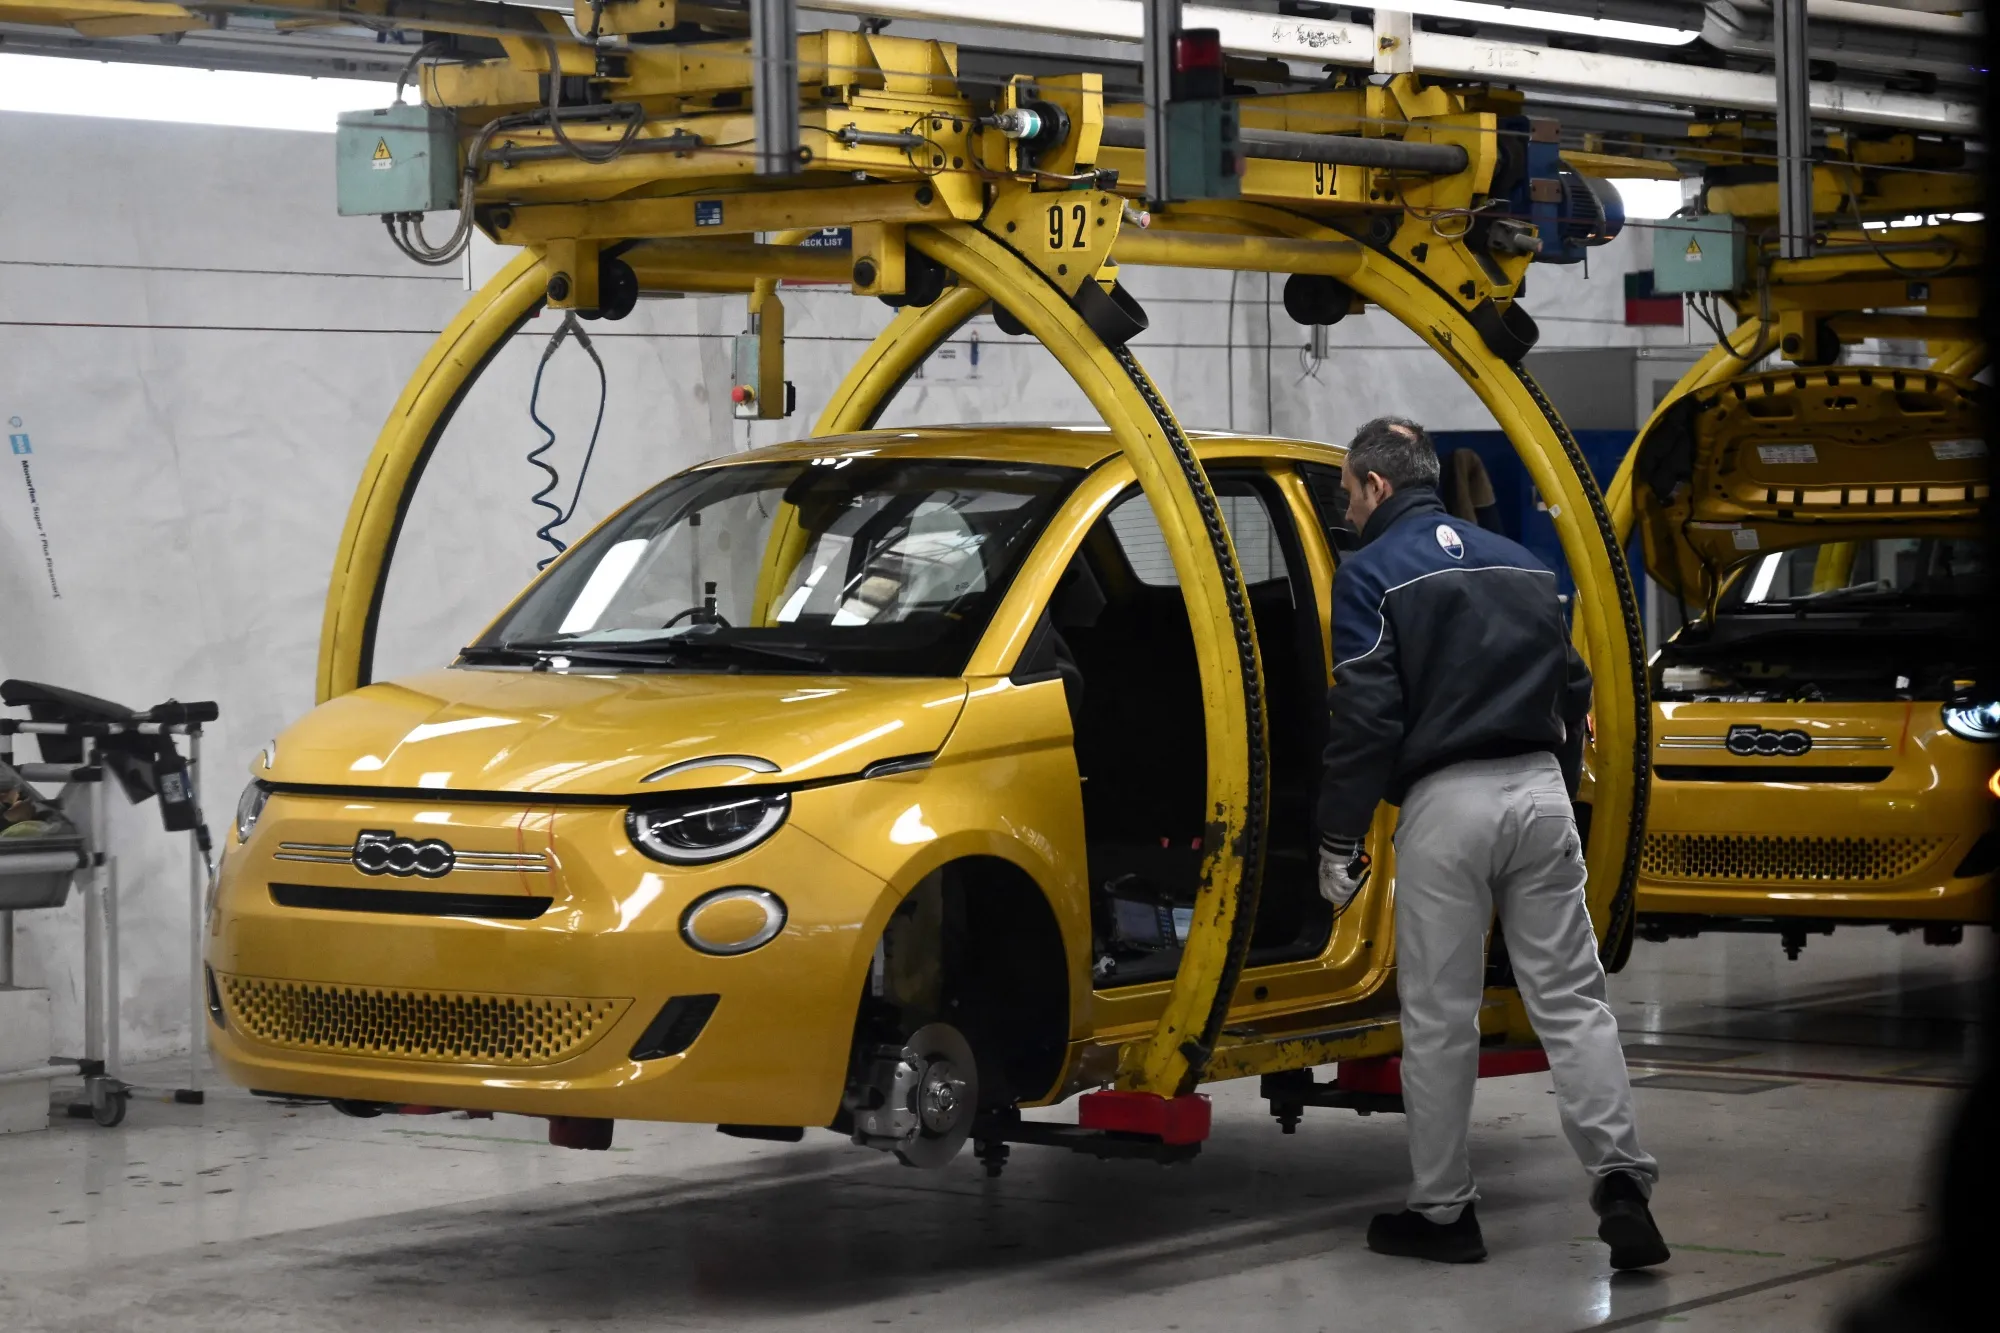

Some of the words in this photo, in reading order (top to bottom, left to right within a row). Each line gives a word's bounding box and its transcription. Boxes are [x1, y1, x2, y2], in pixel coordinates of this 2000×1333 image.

[1315, 162, 1337, 195] 92
[800, 239, 822, 247] HECK
[824, 238, 843, 246] LIST
[1049, 204, 1086, 249] 92
[1727, 726, 1811, 755] 500
[354, 831, 453, 876] 500
